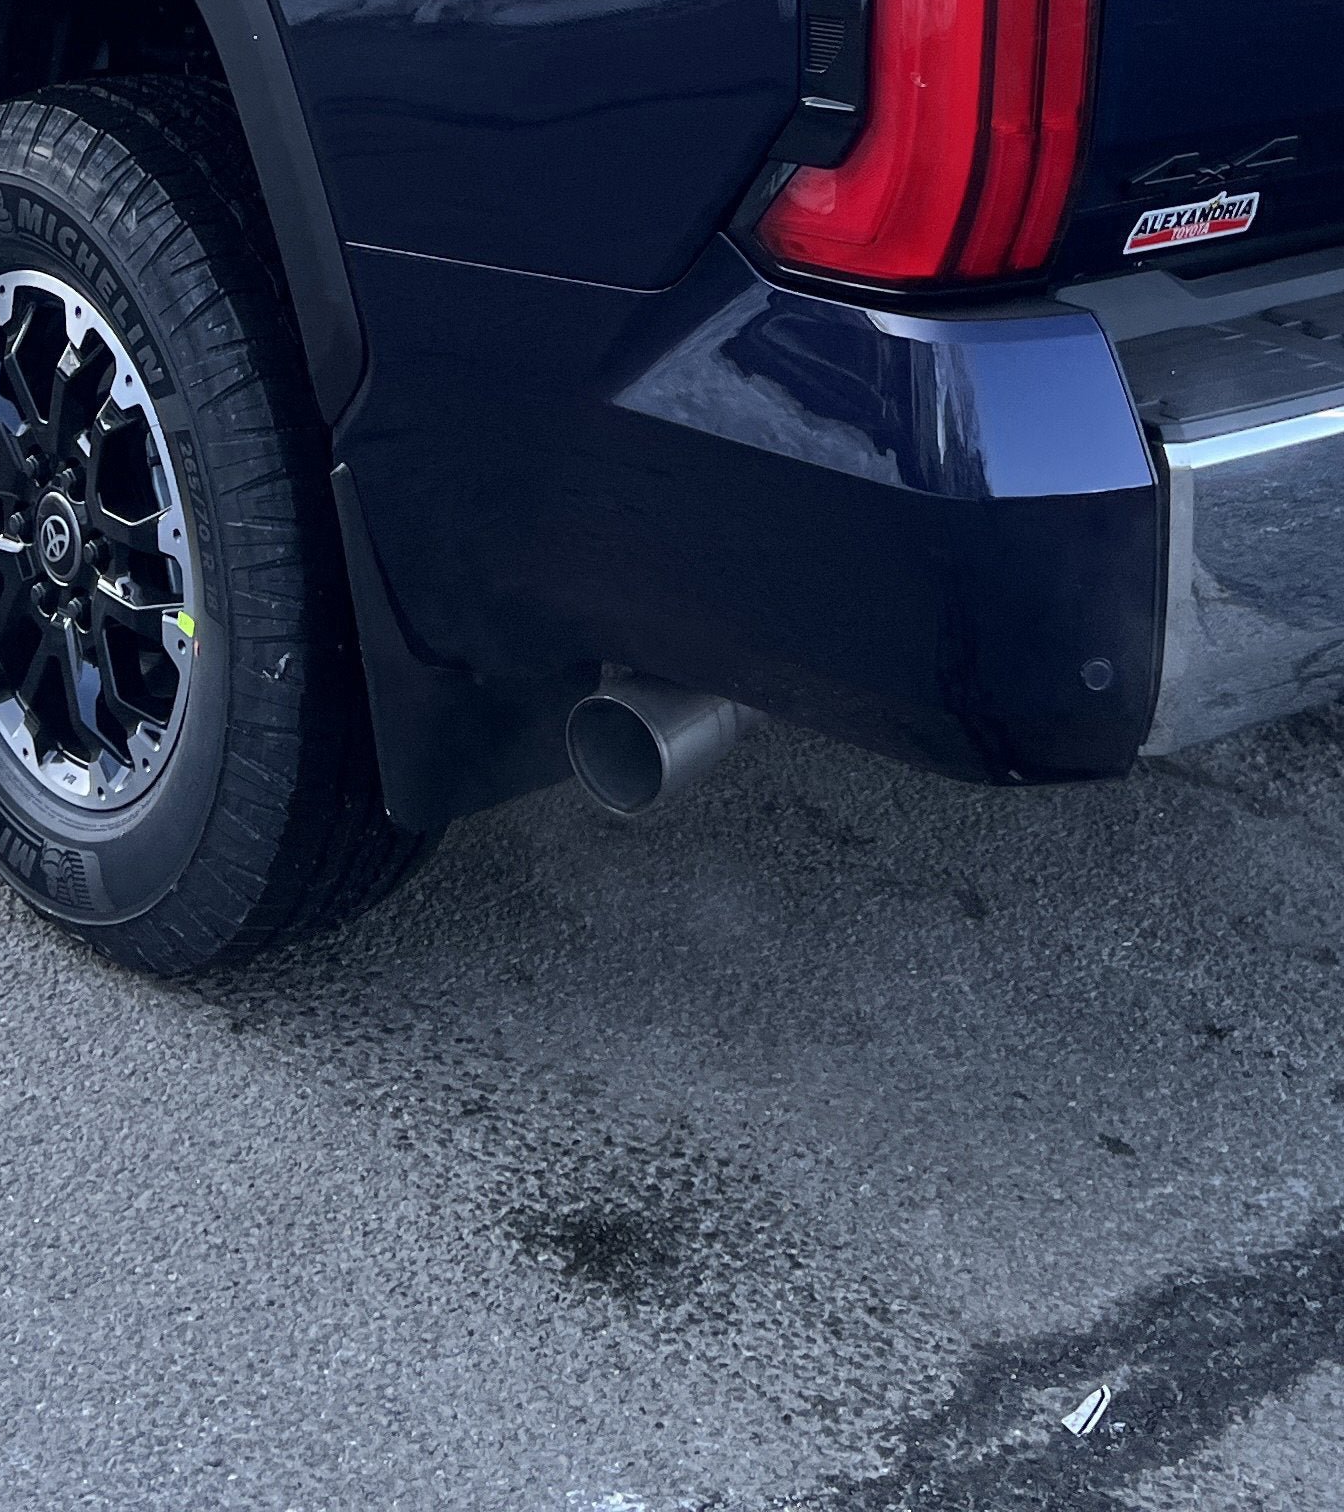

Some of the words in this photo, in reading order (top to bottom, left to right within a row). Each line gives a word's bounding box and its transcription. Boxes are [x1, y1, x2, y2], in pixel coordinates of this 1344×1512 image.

[1133, 197, 1256, 238] ALEXANDRIA
[1170, 222, 1212, 241] TOYOTA
[17, 197, 166, 385] MICHELIN
